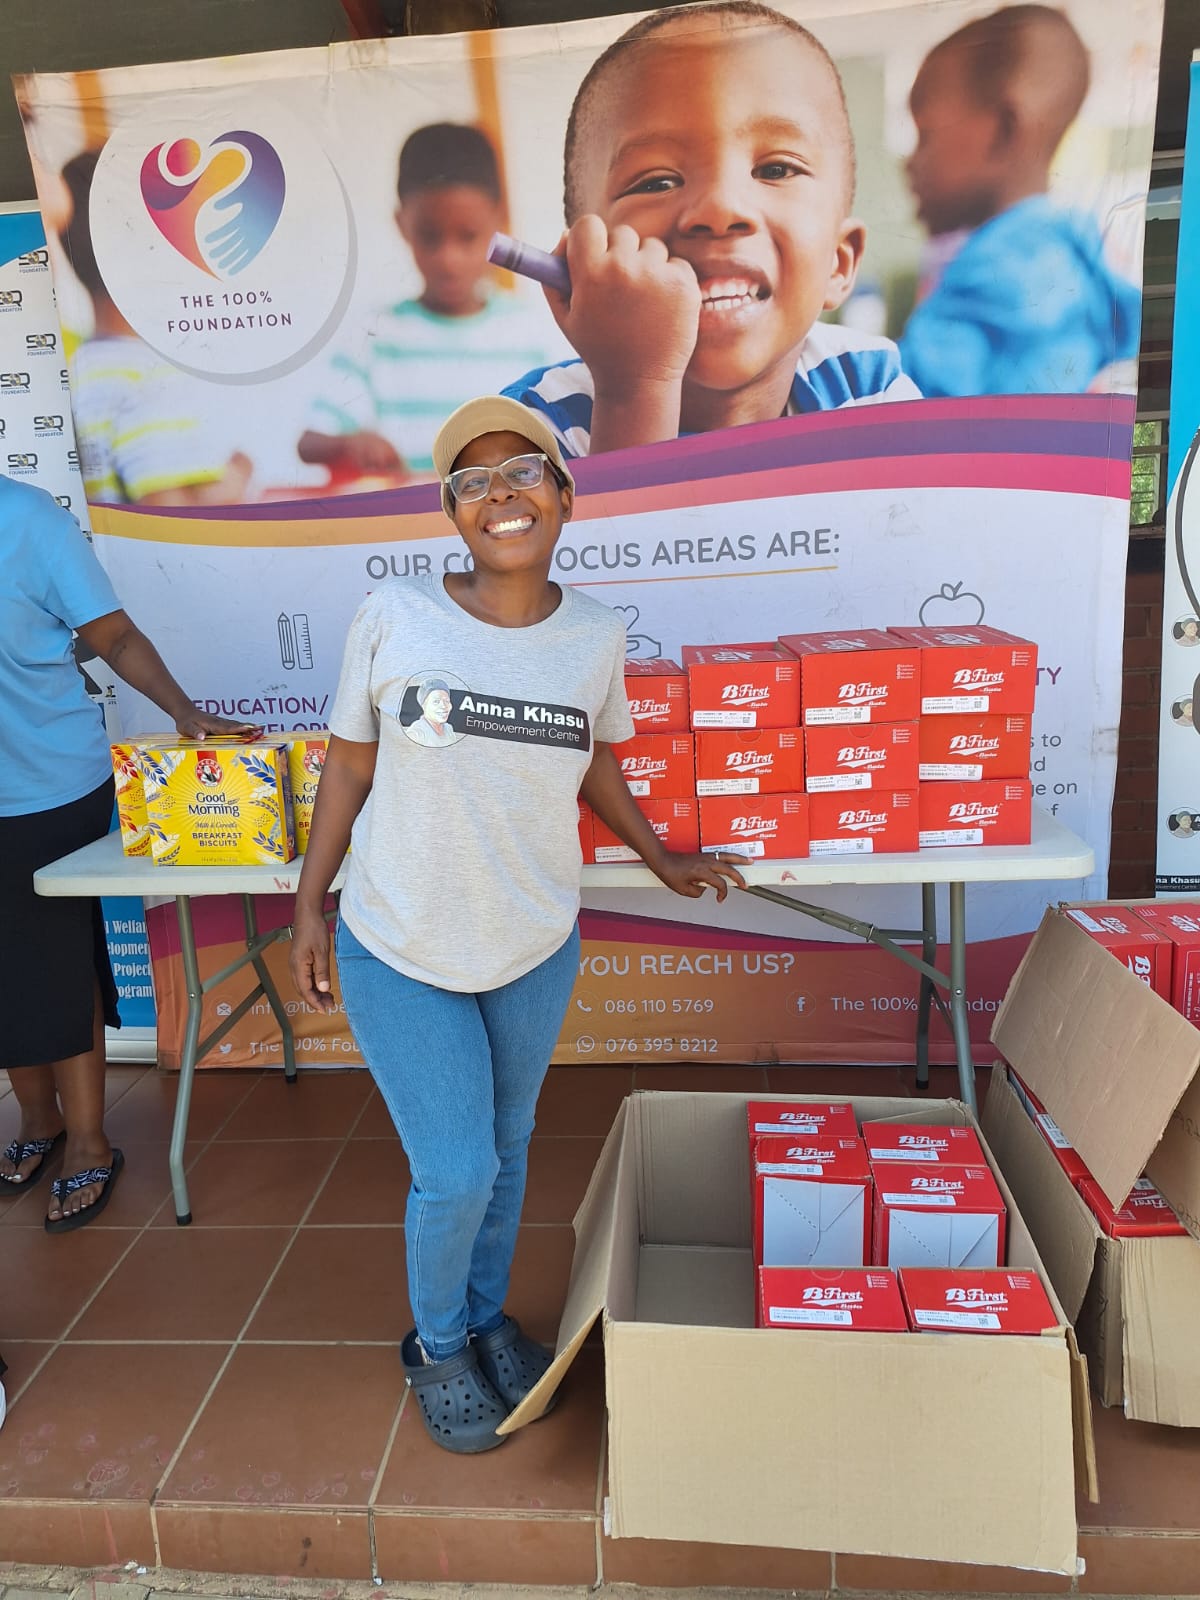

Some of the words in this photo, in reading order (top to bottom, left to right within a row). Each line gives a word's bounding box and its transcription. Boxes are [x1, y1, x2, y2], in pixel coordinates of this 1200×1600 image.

[180, 294, 215, 309] THE
[222, 290, 272, 306] 100%
[167, 312, 292, 333] FOUNDATION
[366, 553, 432, 580] OUR
[556, 543, 642, 573] OCUS
[652, 534, 757, 566] AREAS
[767, 528, 840, 558] ARE:
[459, 695, 516, 720] Anna
[523, 705, 585, 729] Khasu
[466, 715, 546, 738] Empowerment
[548, 727, 580, 742] Centre
[1041, 733, 1062, 747] to
[1053, 782, 1078, 795] on
[196, 792, 226, 803] Good
[188, 803, 240, 817] Morning
[192, 832, 243, 840] BREAKFAST
[579, 955, 630, 976] YOU
[640, 953, 733, 975] REACH
[743, 952, 796, 974] US?
[604, 999, 637, 1014] 086
[641, 999, 667, 1014] 110
[672, 998, 714, 1014] 5769
[831, 996, 865, 1012] The
[870, 996, 918, 1012] 100%
[250, 1042, 280, 1055] The
[606, 1038, 638, 1053] 076
[643, 1038, 674, 1053] 395
[680, 1038, 719, 1053] 8212
